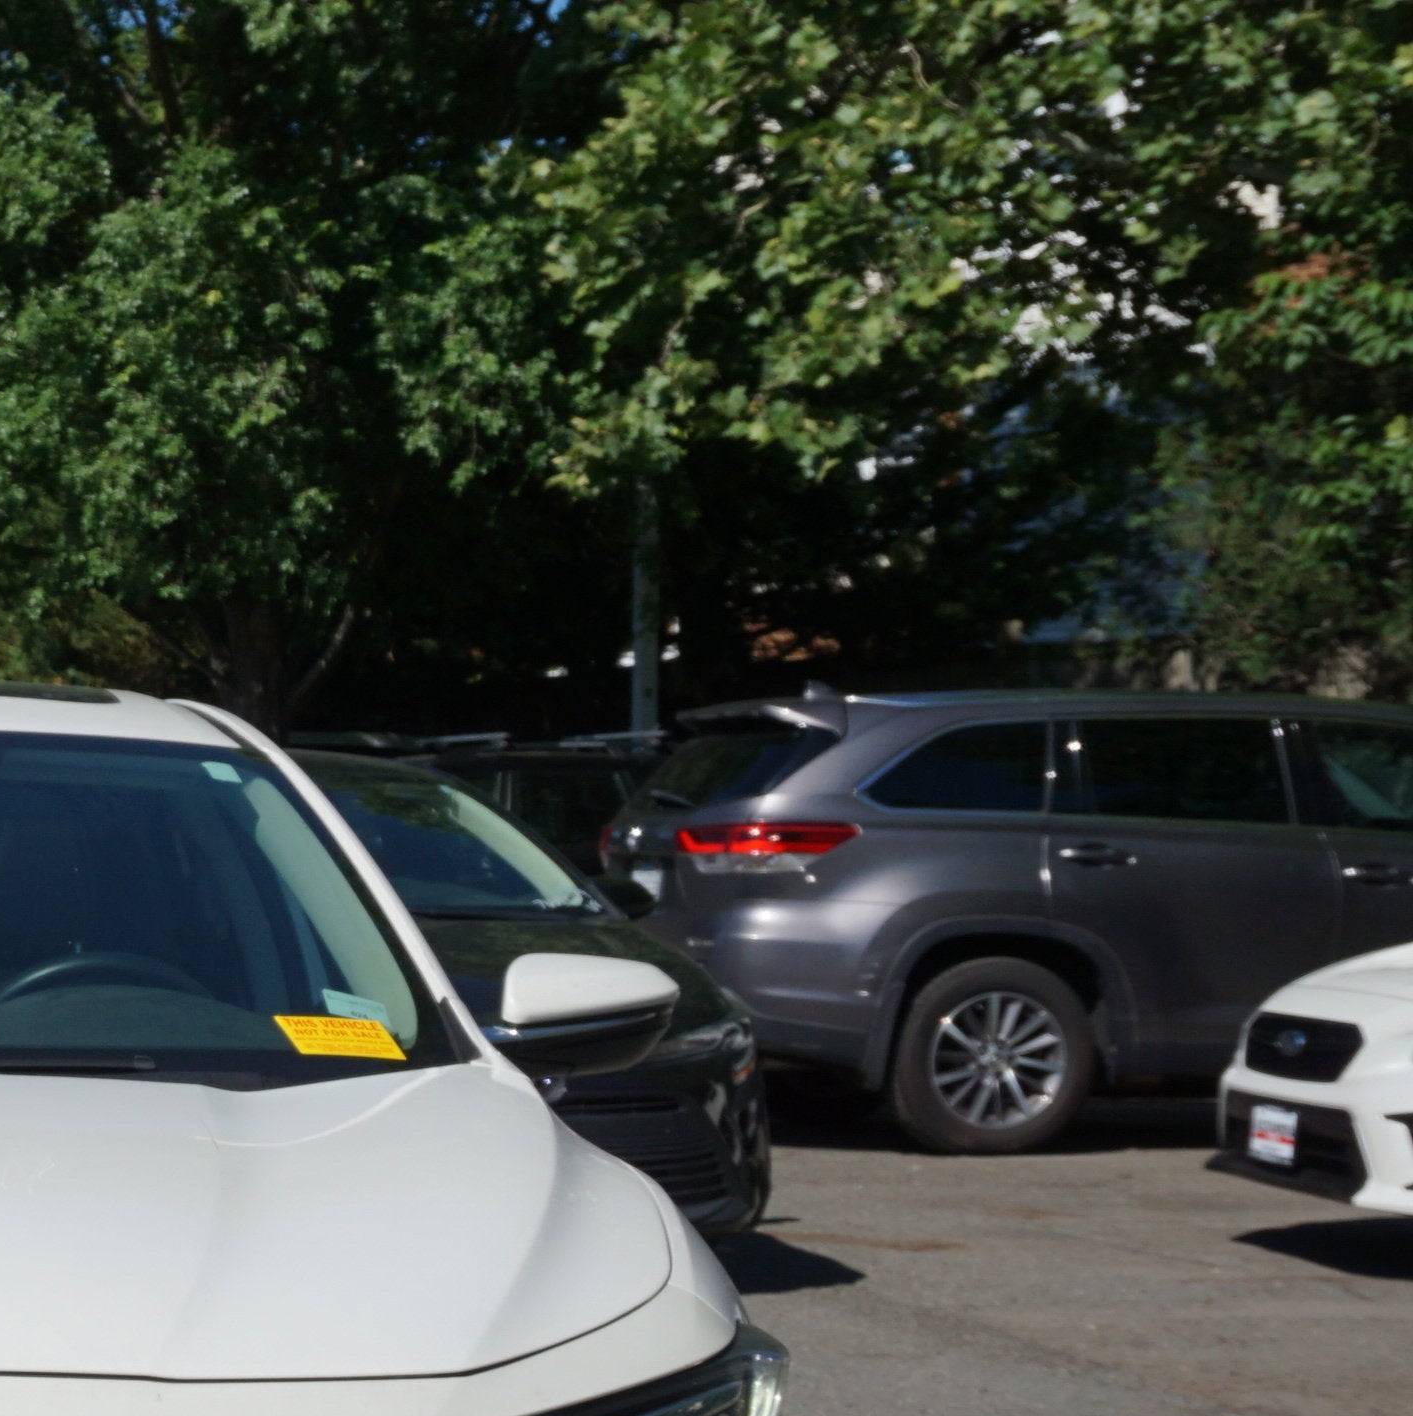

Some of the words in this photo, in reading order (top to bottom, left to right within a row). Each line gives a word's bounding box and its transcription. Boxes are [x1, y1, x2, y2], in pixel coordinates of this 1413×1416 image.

[284, 1018, 318, 1028] THIS
[320, 1019, 381, 1031] VEHICLE
[294, 1028, 320, 1036] NOT
[323, 1029, 348, 1037] FOR
[352, 1030, 385, 1039] SALE
